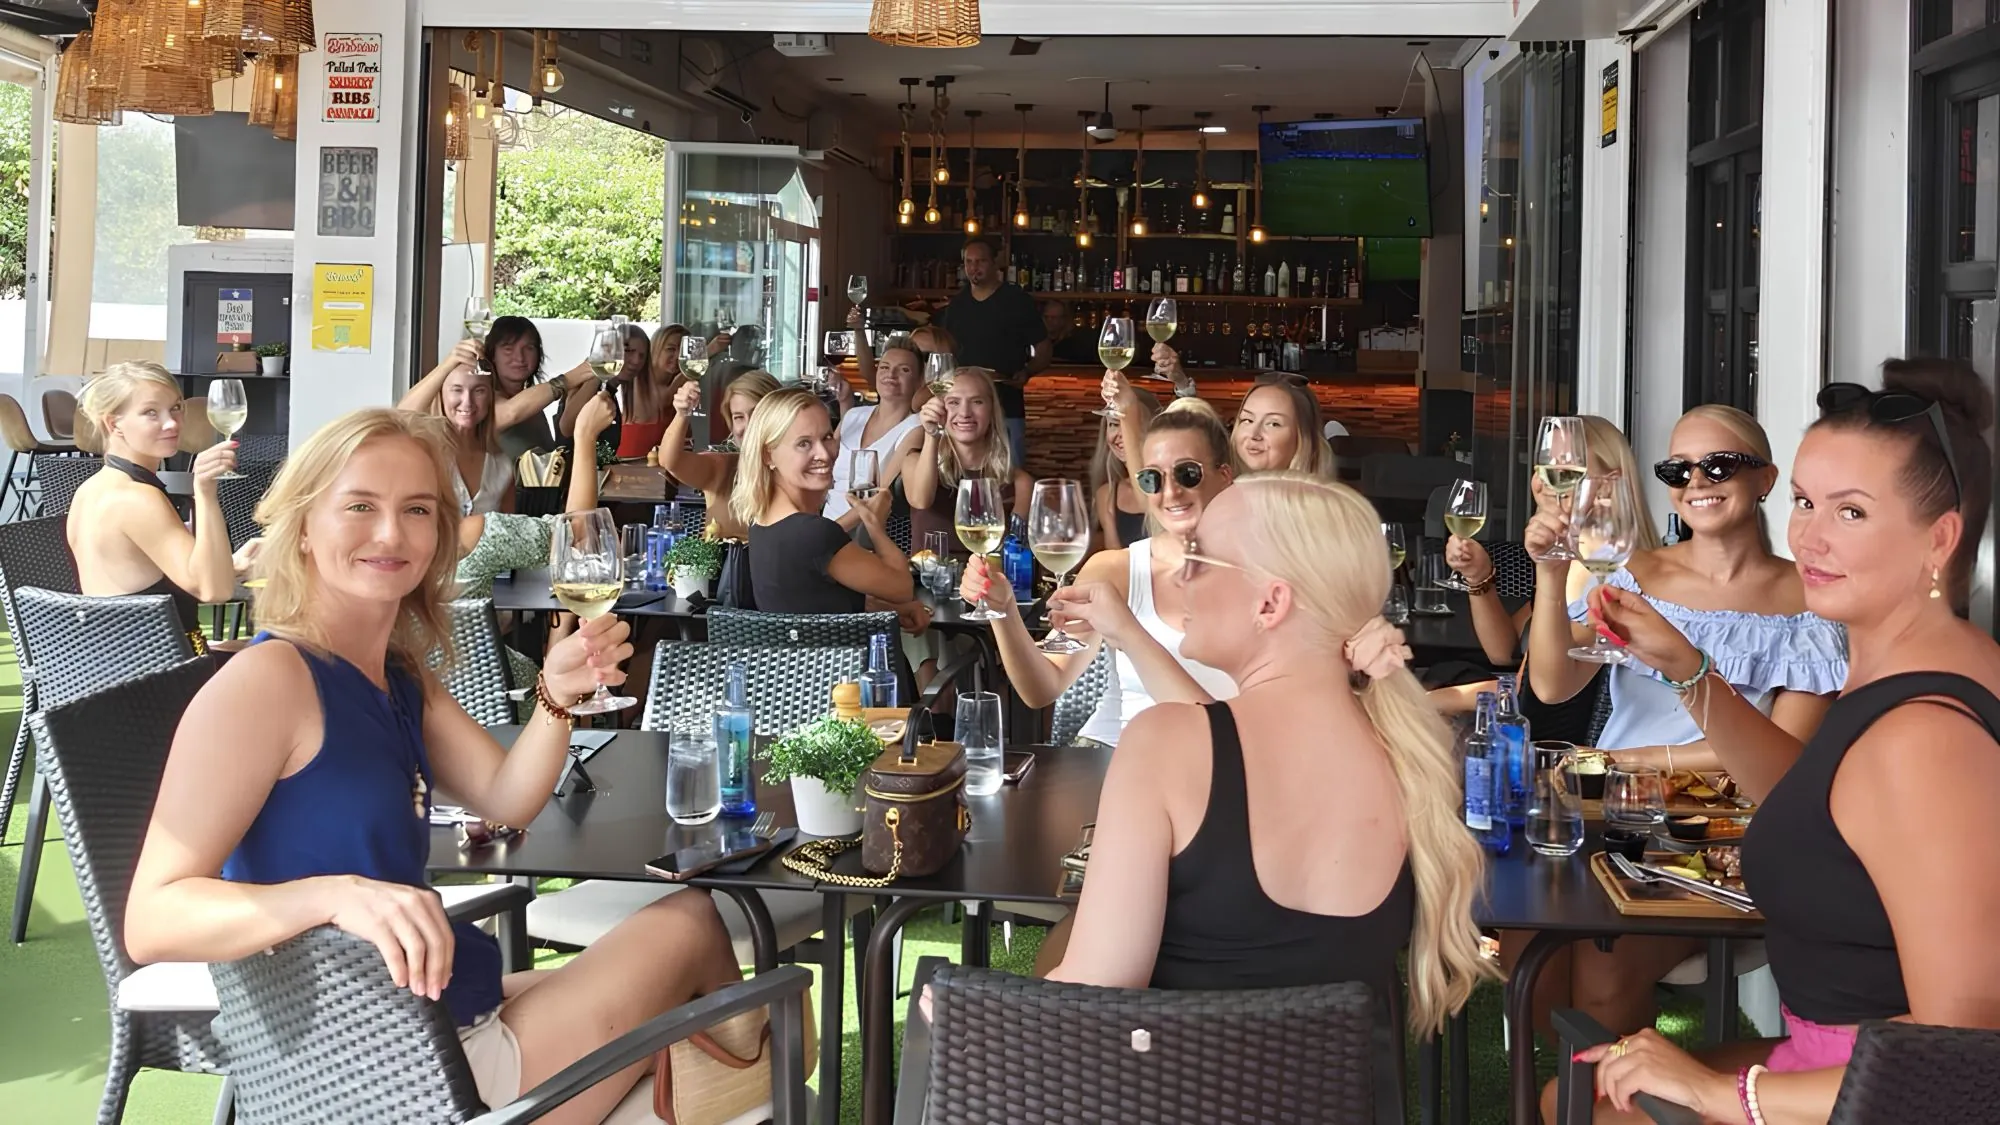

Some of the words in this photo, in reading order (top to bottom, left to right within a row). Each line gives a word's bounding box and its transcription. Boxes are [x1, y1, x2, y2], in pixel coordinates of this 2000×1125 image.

[332, 92, 371, 105] RIBS
[323, 153, 374, 175] BEER
[338, 177, 359, 203] &
[322, 206, 372, 230] BBQ
